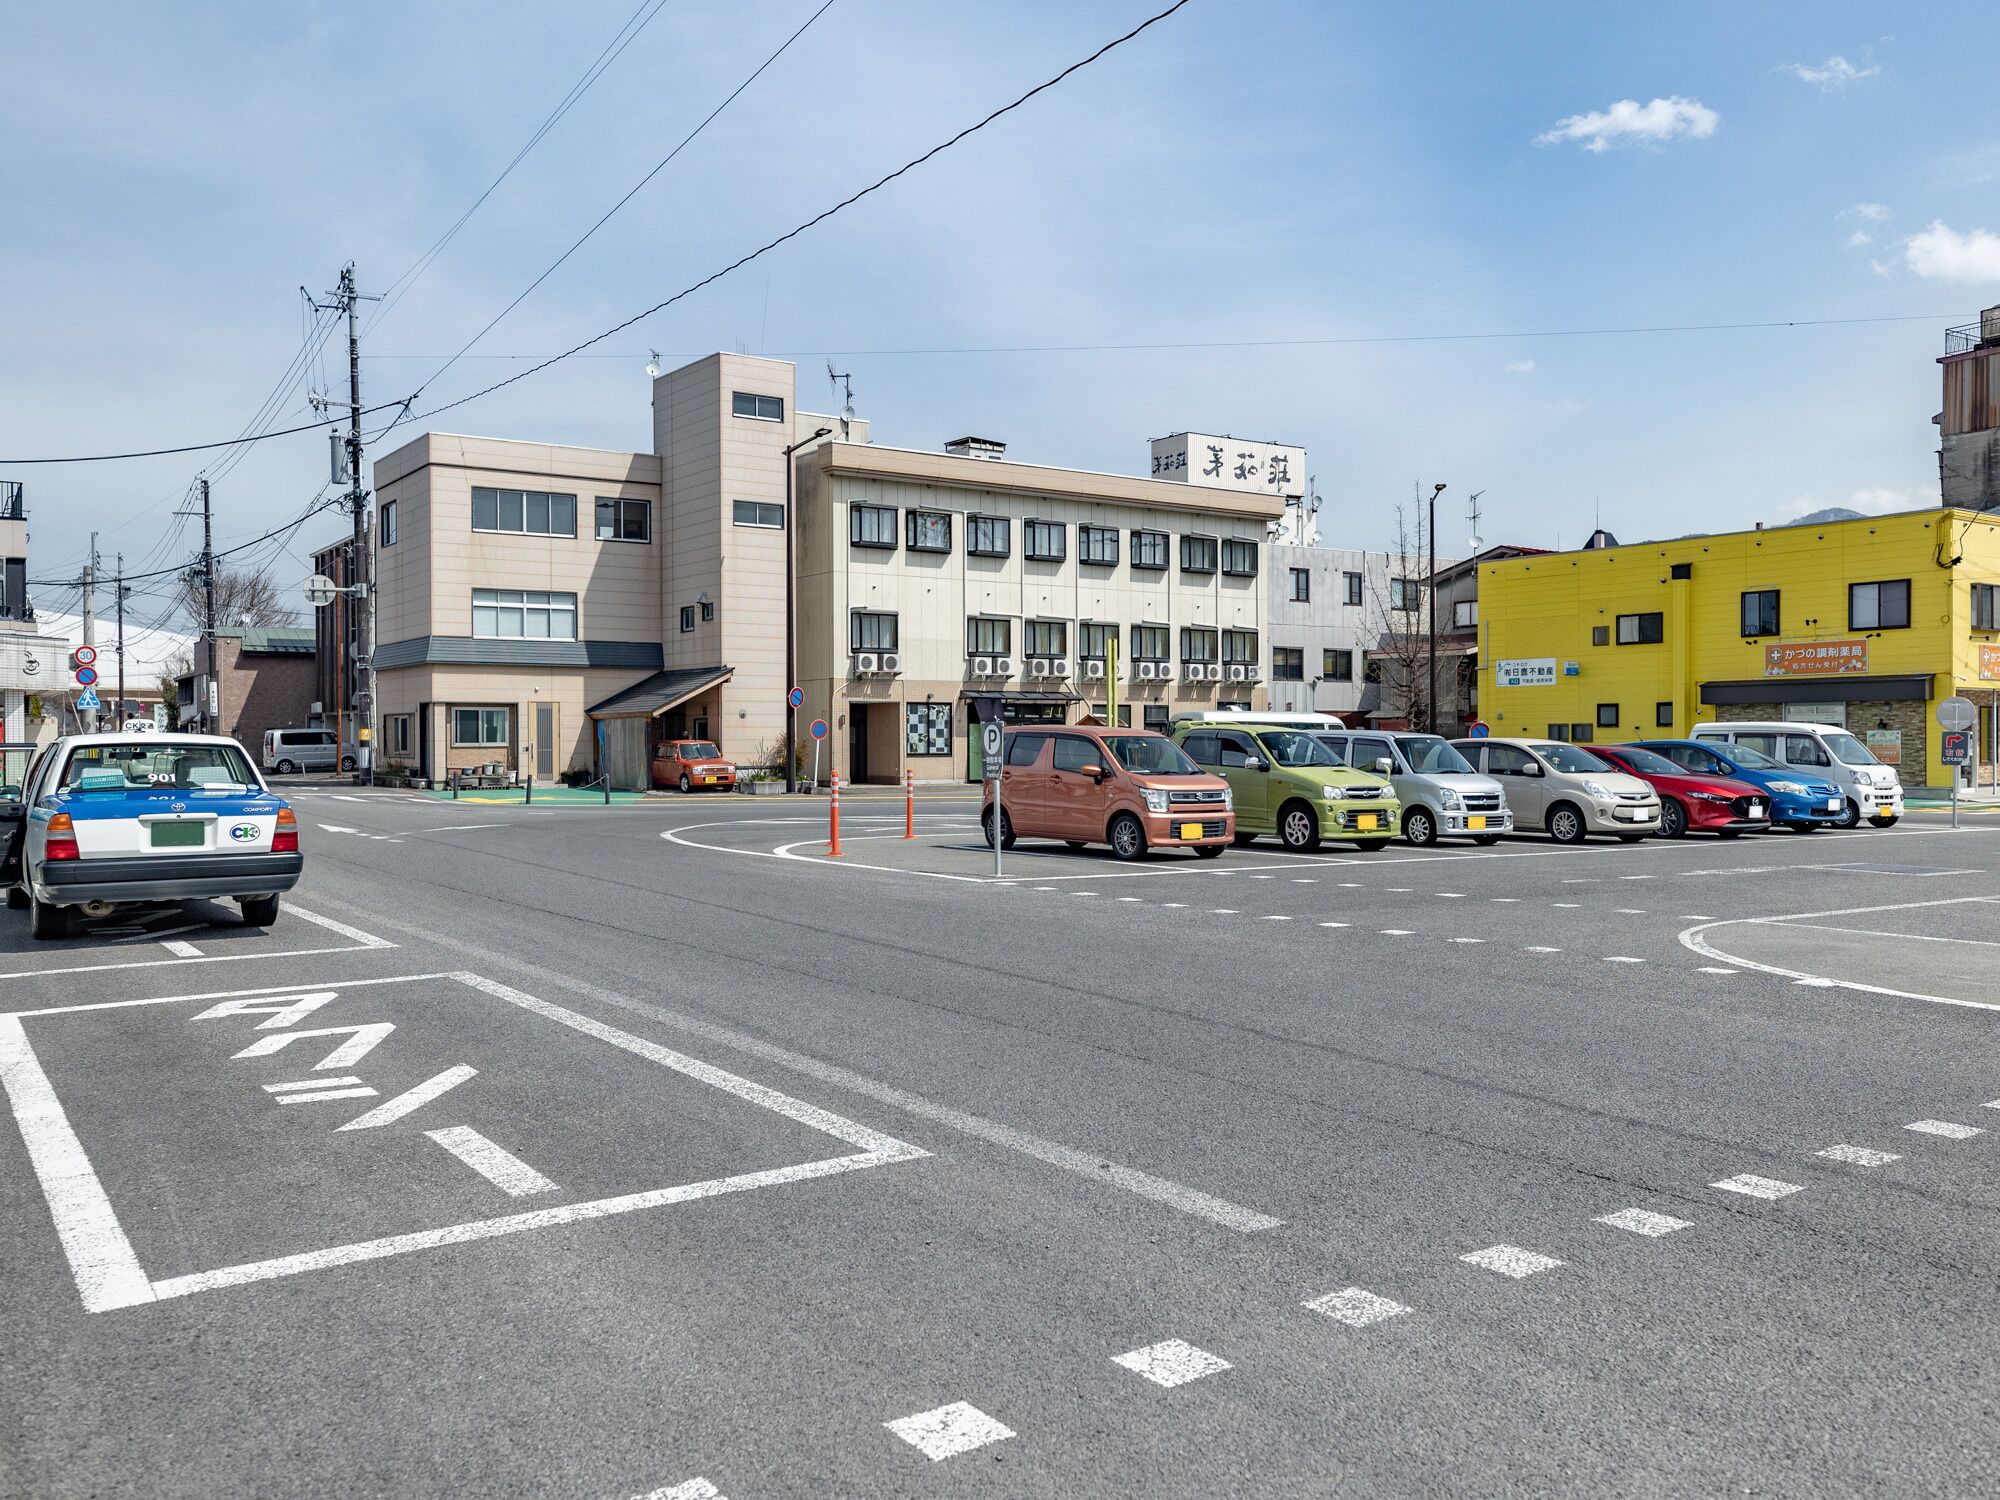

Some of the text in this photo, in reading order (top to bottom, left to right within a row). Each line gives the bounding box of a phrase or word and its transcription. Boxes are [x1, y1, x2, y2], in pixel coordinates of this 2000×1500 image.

[80, 651, 92, 660] 30
[1784, 645, 1862, 660] かづの調剤薬局
[988, 729, 997, 750] P
[147, 773, 176, 783] 901
[231, 827, 256, 839] CK
[188, 991, 561, 1198] タクシー
